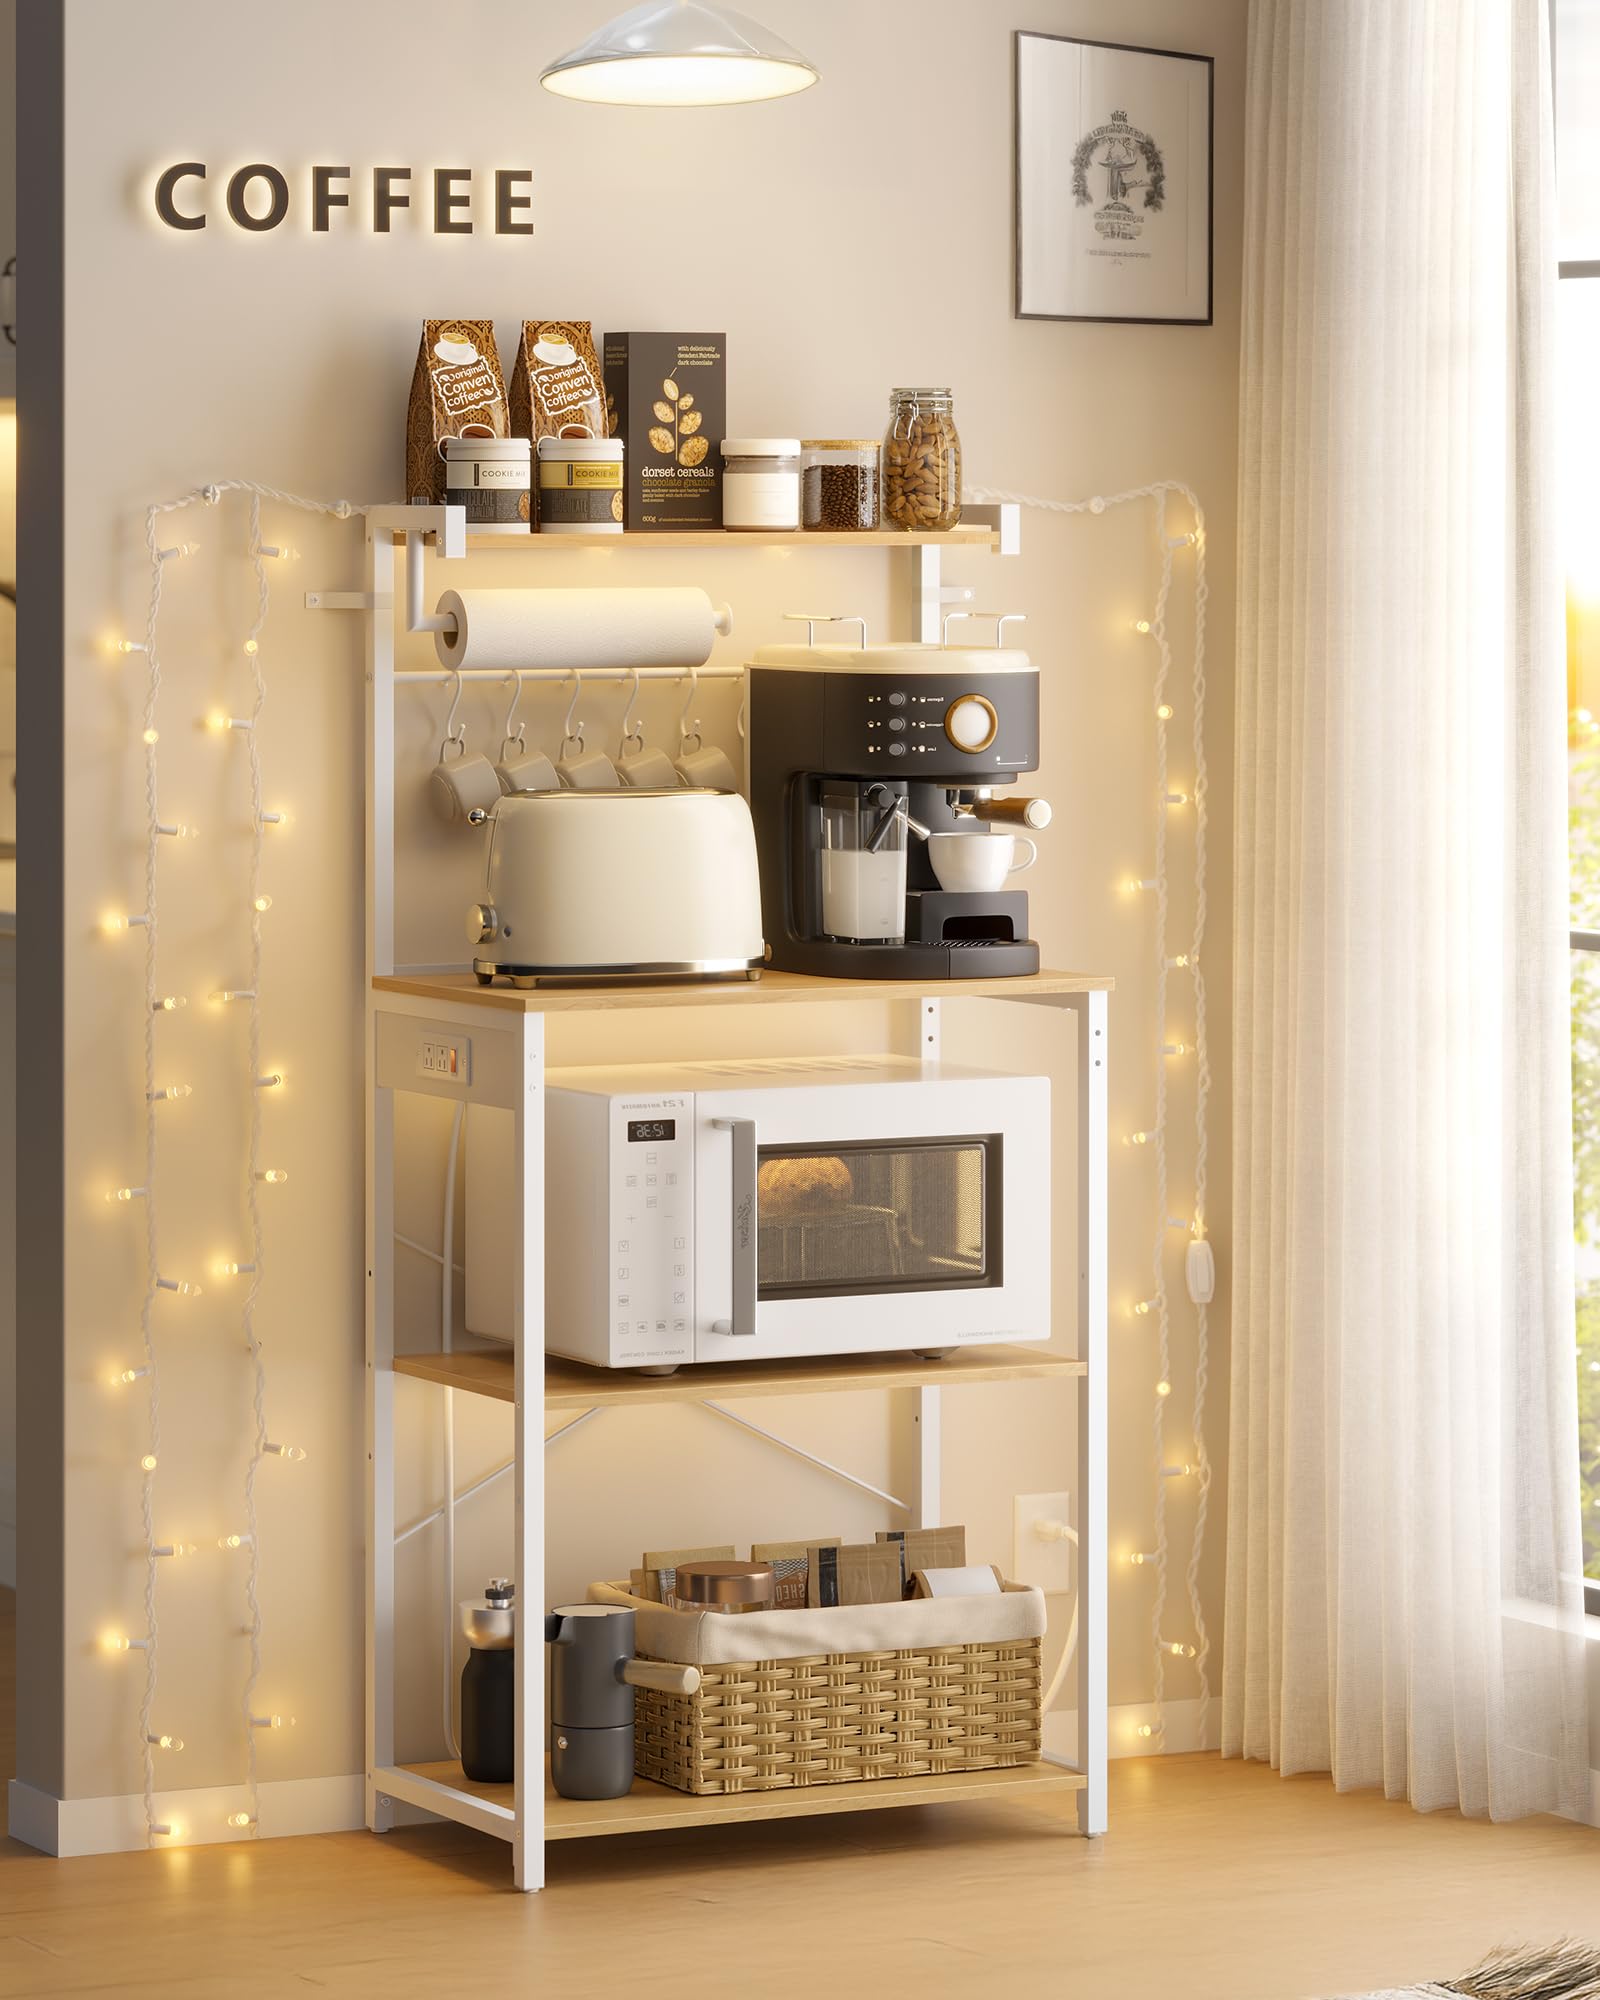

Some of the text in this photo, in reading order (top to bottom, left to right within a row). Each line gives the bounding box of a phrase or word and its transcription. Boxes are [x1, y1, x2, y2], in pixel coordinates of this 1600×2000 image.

[155, 162, 534, 235] COFFEE
[454, 362, 486, 379] original
[553, 362, 584, 380] original
[443, 374, 491, 396] Conven
[542, 374, 590, 396] Conven
[447, 390, 481, 407] coffee
[546, 391, 580, 407] coffee
[642, 466, 715, 477] dorset cereals
[642, 478, 716, 489] chocolate granola
